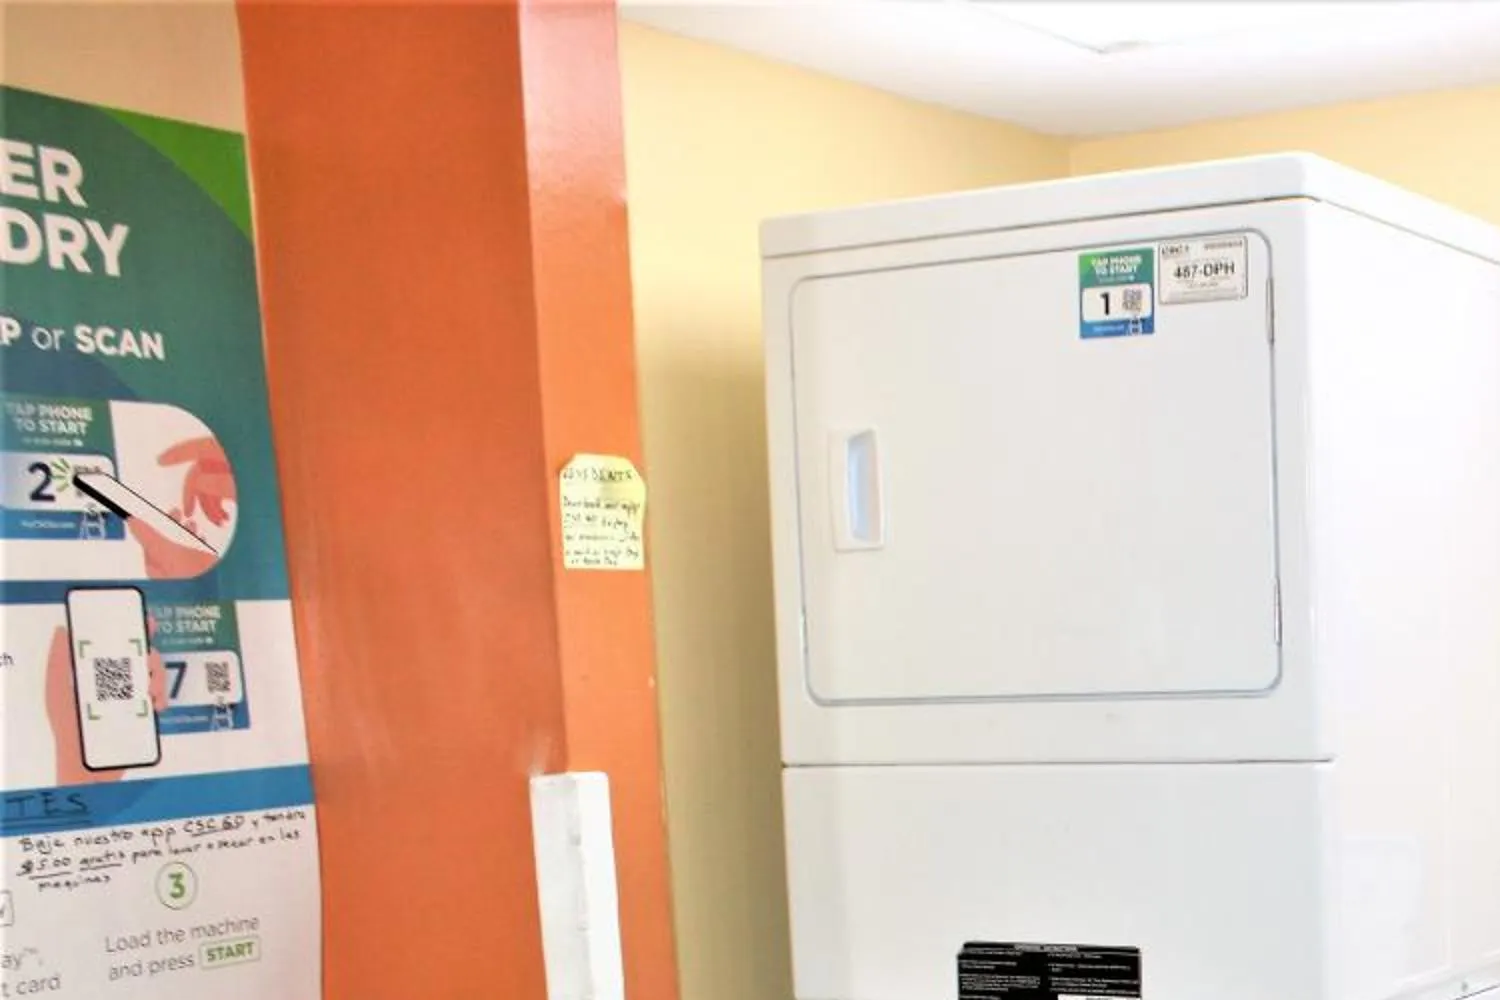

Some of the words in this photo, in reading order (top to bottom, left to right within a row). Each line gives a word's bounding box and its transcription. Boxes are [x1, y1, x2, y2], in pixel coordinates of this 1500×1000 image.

[0, 205, 130, 278] DRY
[1100, 292, 1110, 316] 1
[31, 326, 64, 350] or
[74, 323, 165, 361] SCAN
[38, 404, 93, 421] PHONE
[40, 420, 88, 436] START
[28, 461, 56, 502] 2
[164, 661, 188, 699] 7
[140, 825, 176, 847] app
[183, 818, 217, 837] CSC
[280, 827, 300, 841] las
[168, 872, 186, 899] 3
[104, 929, 152, 953] Load
[156, 927, 186, 946] the
[190, 916, 261, 939] machine
[108, 959, 143, 982] and
[149, 953, 195, 977] press
[207, 941, 255, 963] START
[16, 973, 61, 996] card
